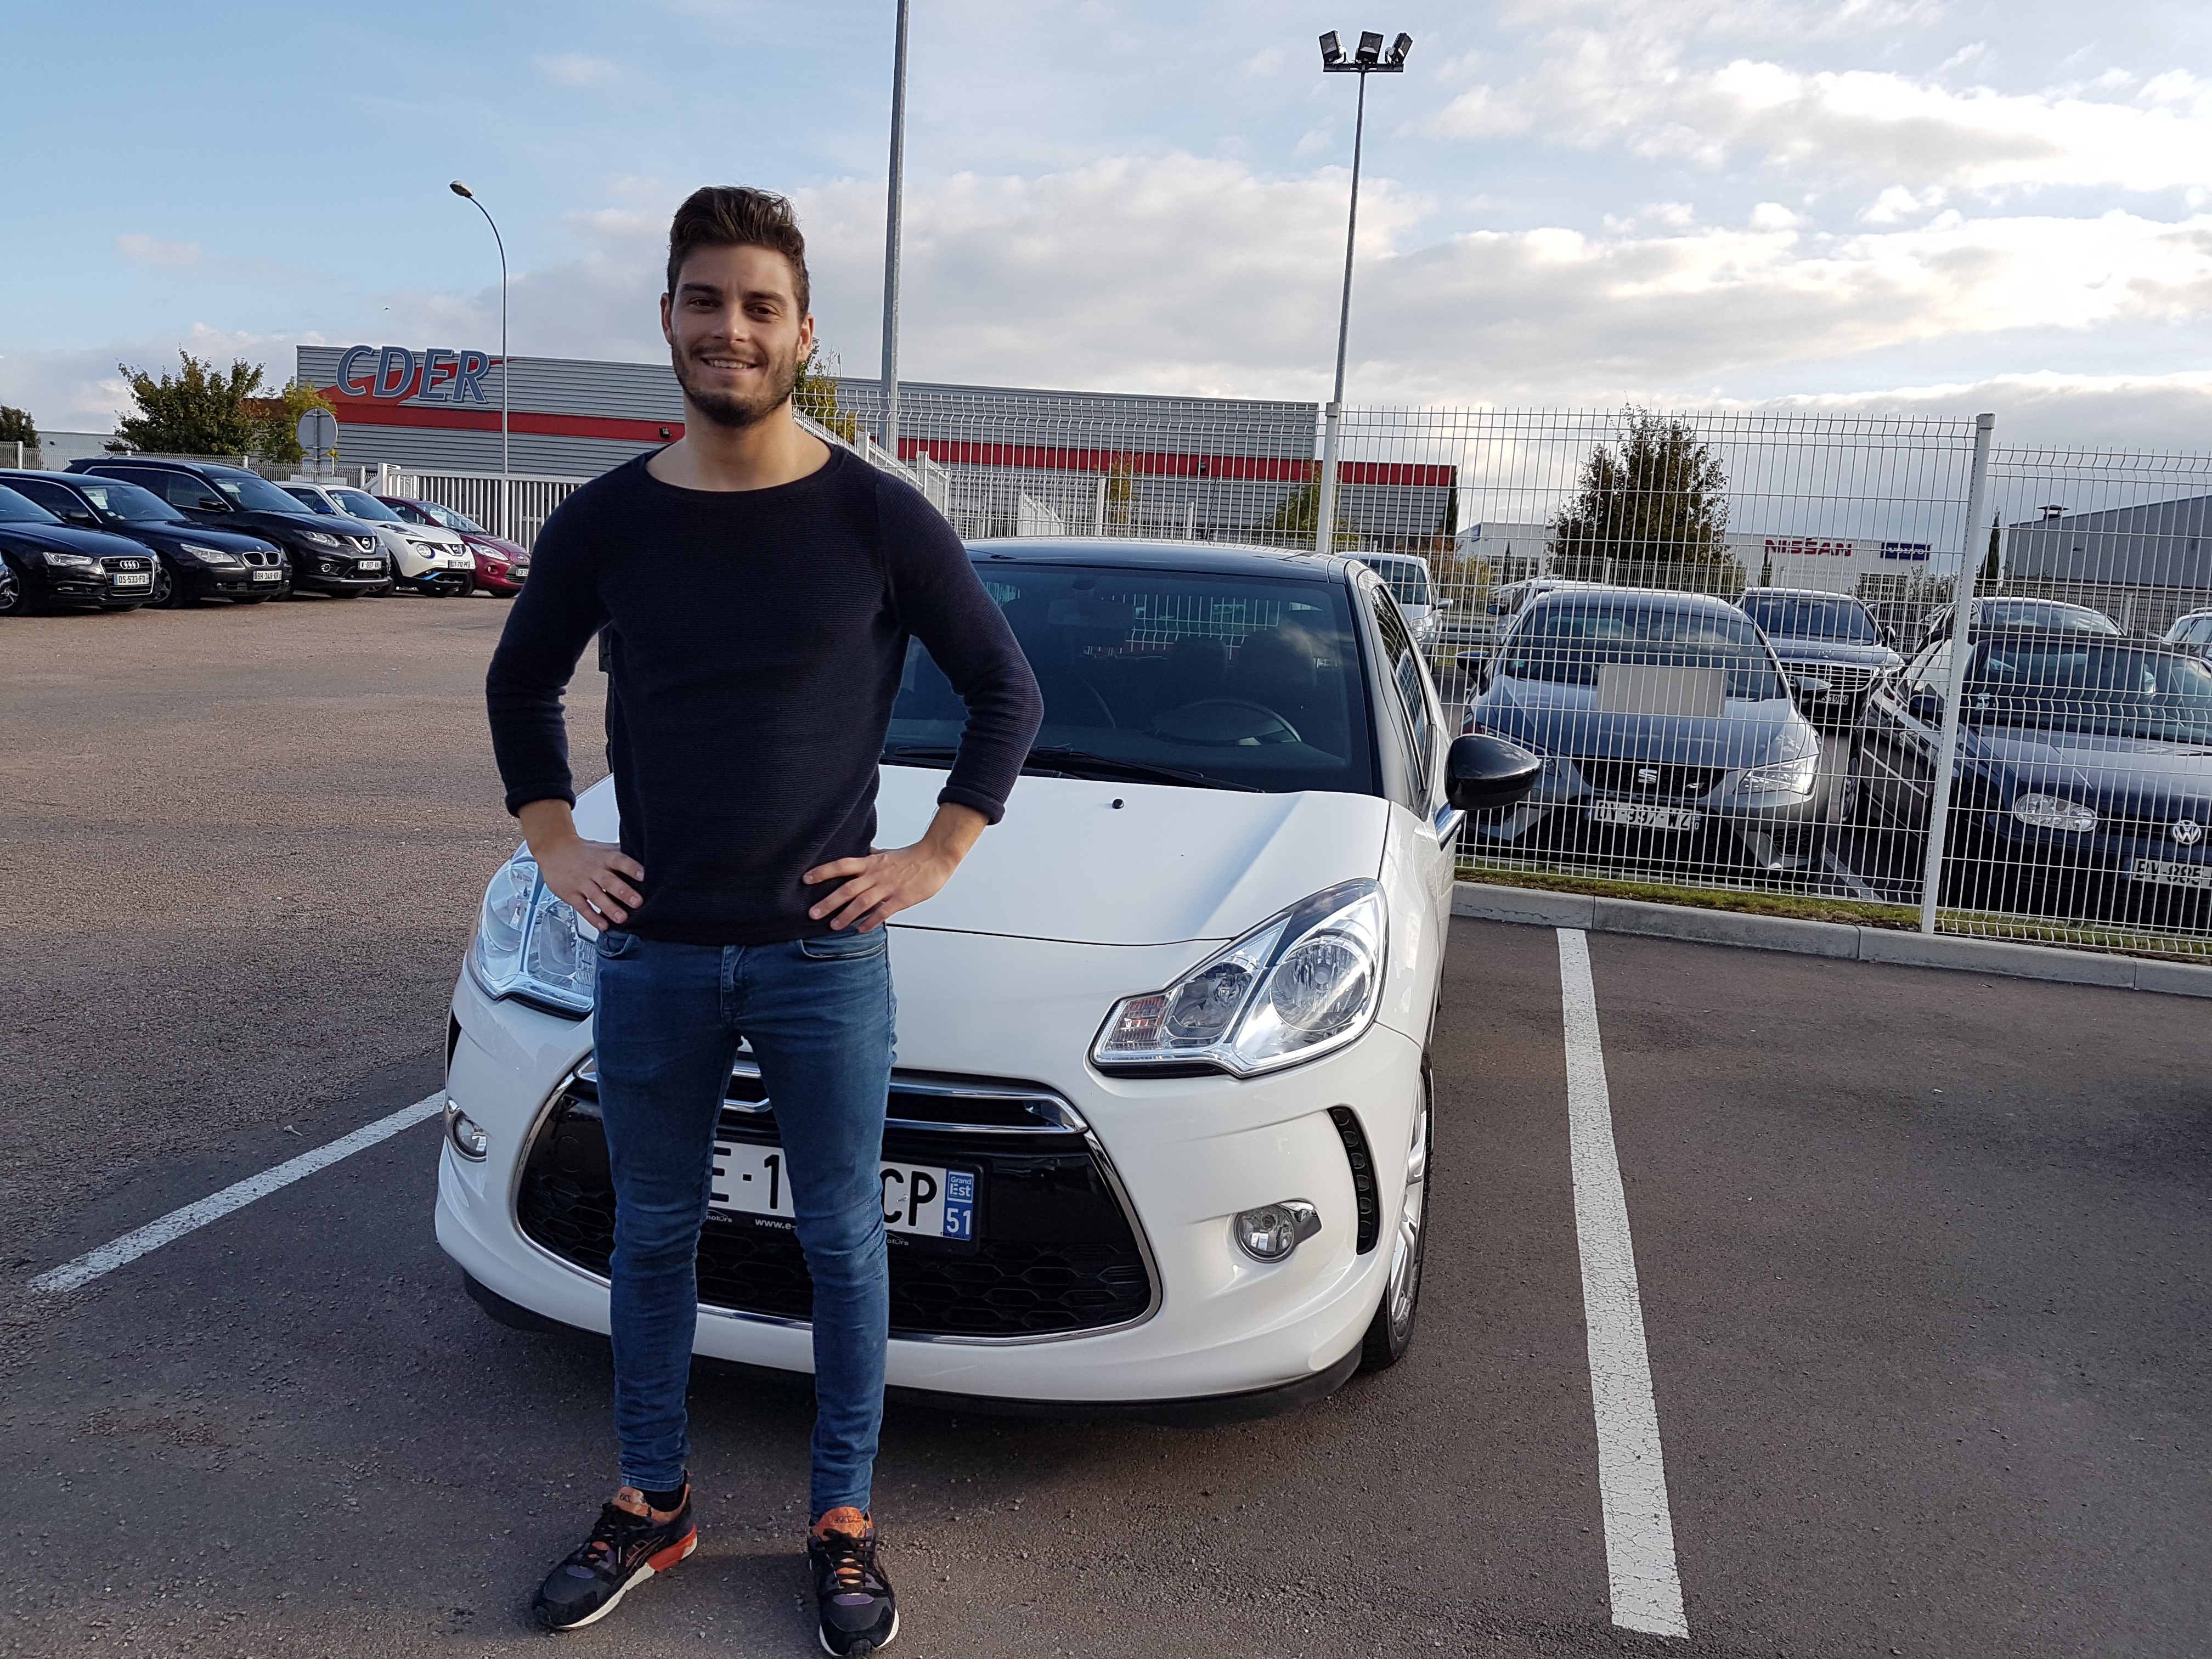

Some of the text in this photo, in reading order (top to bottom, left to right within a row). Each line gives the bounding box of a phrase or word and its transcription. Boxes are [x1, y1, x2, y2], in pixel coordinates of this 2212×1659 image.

[336, 345, 490, 404] CDER
[1765, 539, 1852, 556] NISSAN
[119, 575, 145, 583] DS-533-FD
[2135, 860, 2212, 887] BV-885-
[950, 1176, 972, 1185] Grand
[950, 1183, 971, 1197] Est
[946, 1207, 971, 1235] 51
